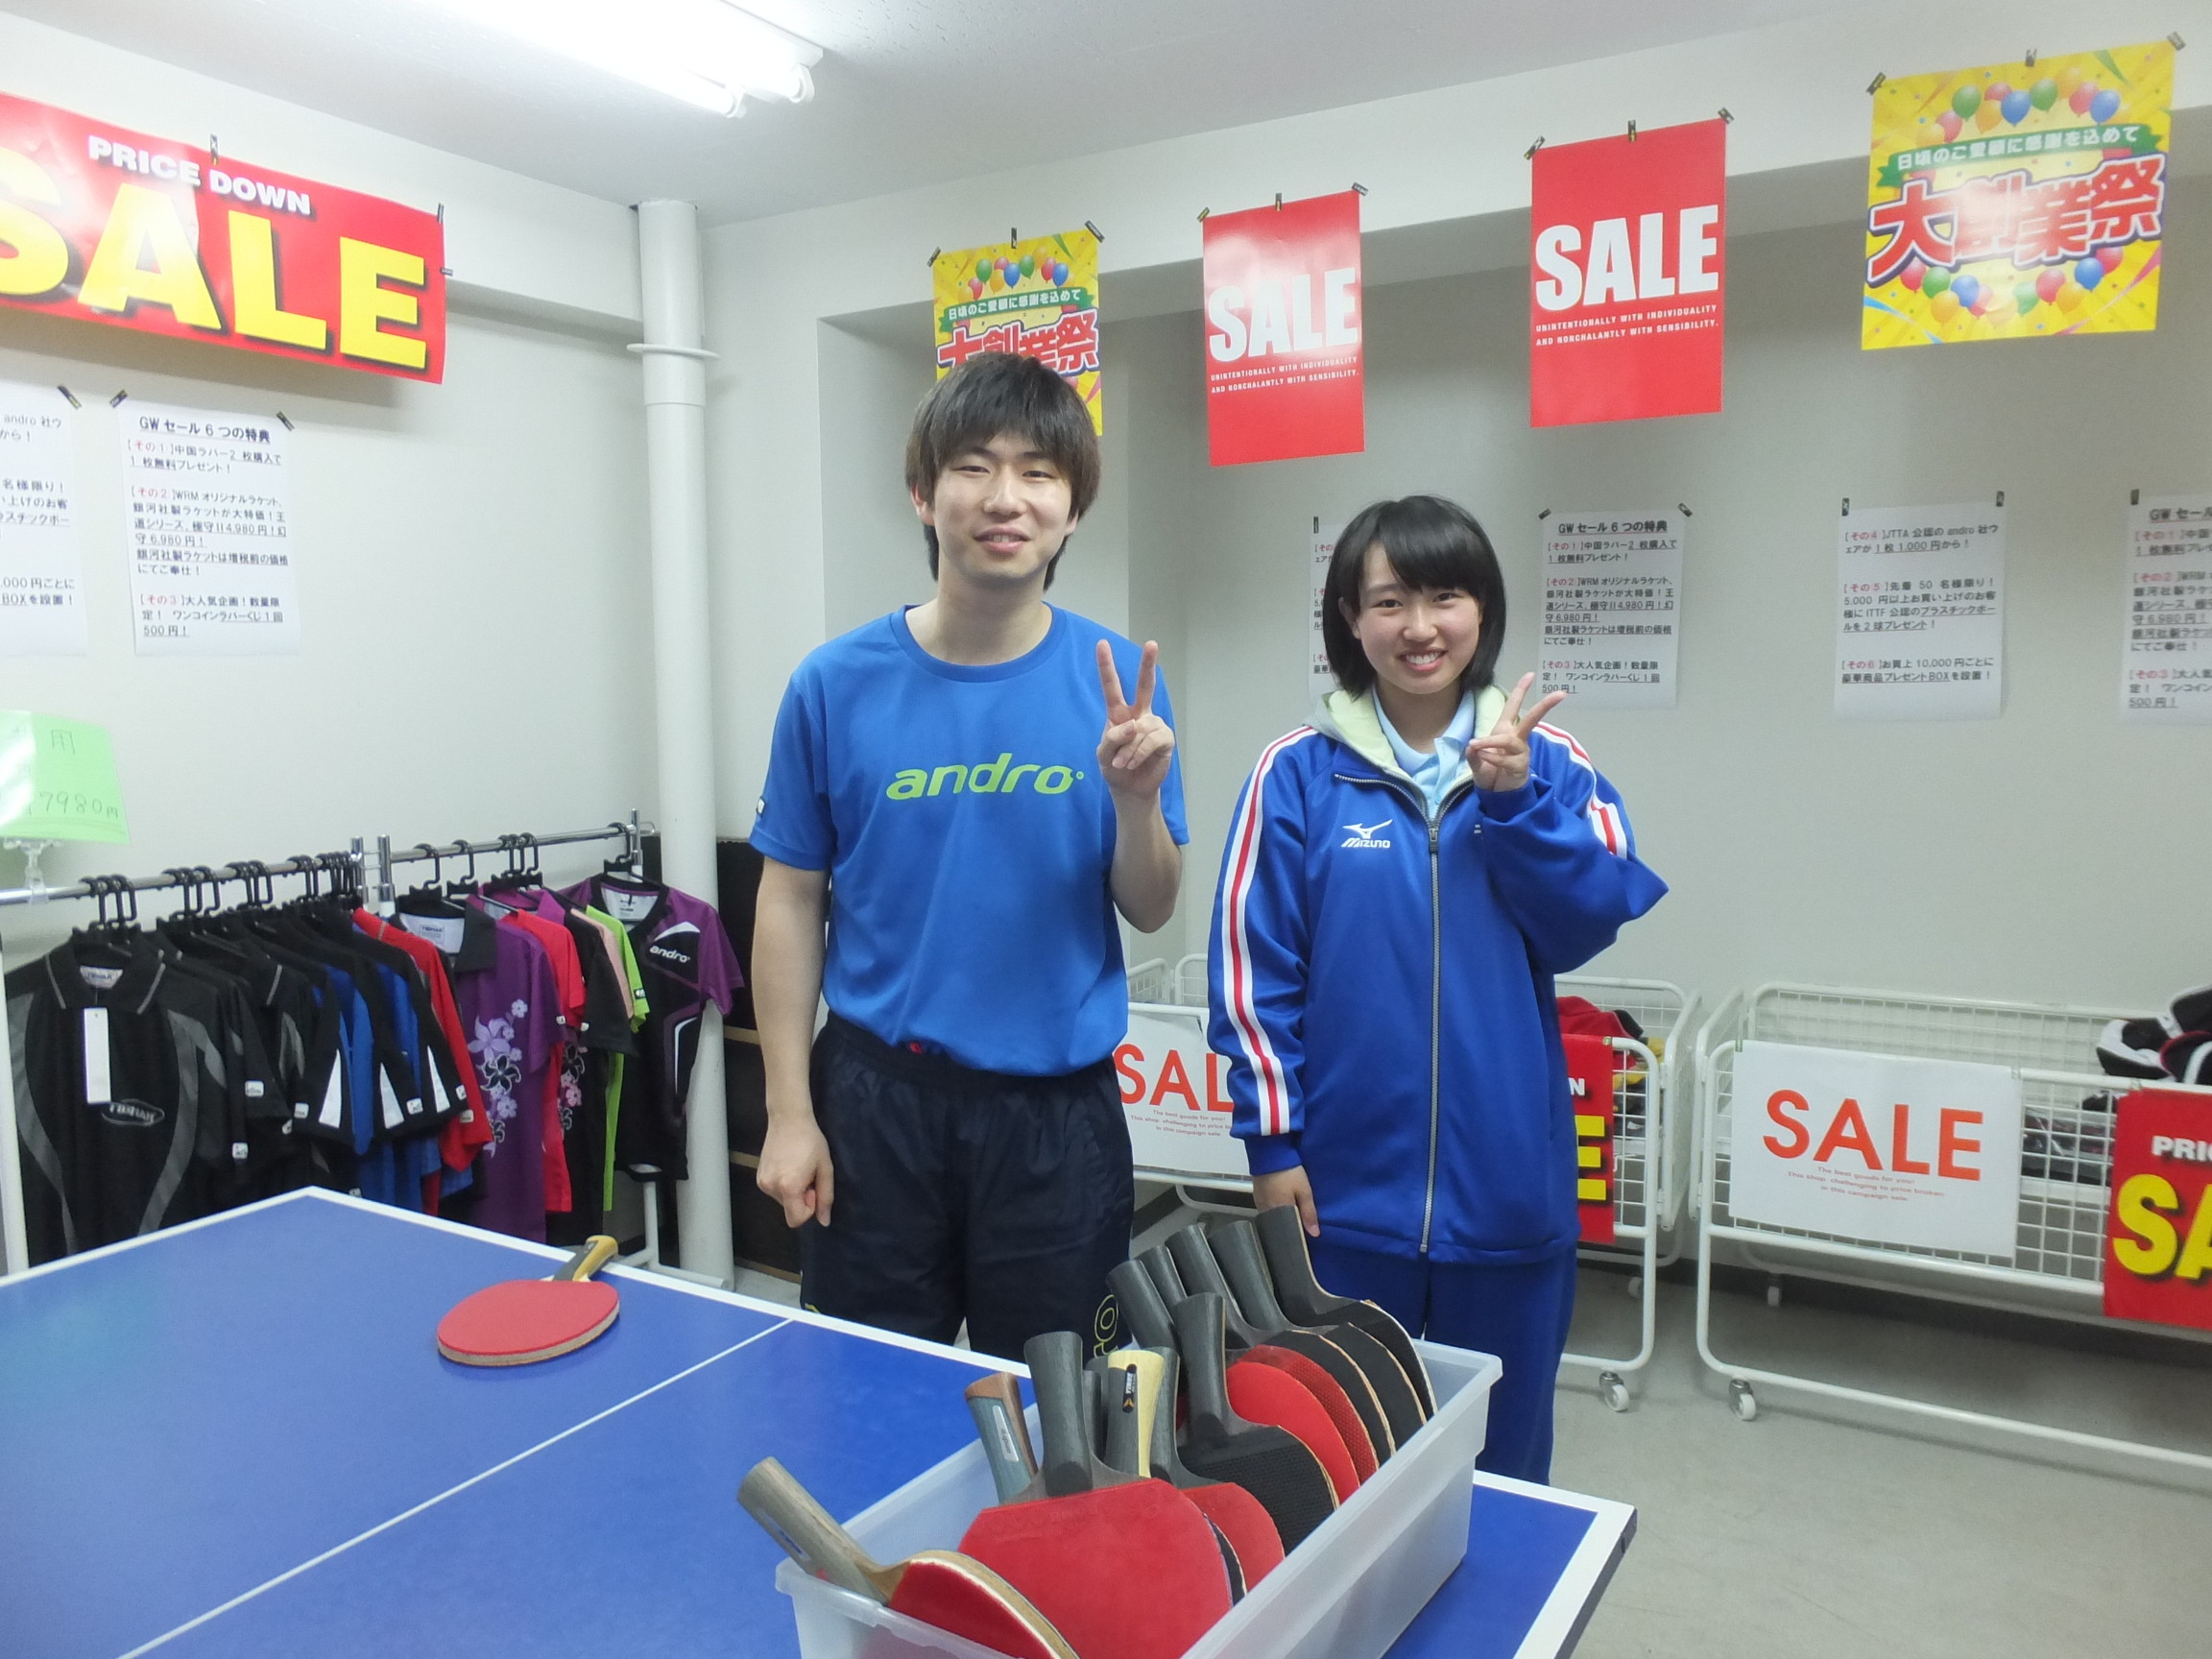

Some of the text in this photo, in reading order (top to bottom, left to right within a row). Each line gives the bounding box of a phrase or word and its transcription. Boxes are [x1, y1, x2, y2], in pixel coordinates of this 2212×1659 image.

[88, 135, 312, 215] PRICE DOWN
[1868, 154, 2164, 282] 大創業祭
[1535, 204, 1719, 311] SALE
[949, 289, 1081, 321] 日頃のご愛顧に感謝を込めて
[1208, 267, 1358, 362] SALE
[1536, 304, 1717, 332] UNINTENTIONALLY WITH INDIVIDUALITY
[1536, 337, 1553, 346] AND
[1630, 325, 1652, 336] WITH
[1279, 364, 1298, 373] WITH
[1301, 356, 1357, 370] INDIVIDUALITY
[1212, 385, 1226, 394] AND
[1287, 375, 1306, 384] WITH
[886, 753, 1074, 801] andro
[1341, 837, 1390, 849] MIZUNO
[650, 946, 687, 963] andro
[1163, 1119, 1197, 1129] challenging
[1175, 1128, 1207, 1137] campaign
[1763, 1089, 1984, 1182] SALE
[1788, 1170, 1804, 1179] This
[1830, 1177, 1878, 1190] challenging
[1890, 1186, 1912, 1194] price
[1816, 1166, 1832, 1174] The
[1834, 1168, 1852, 1177] best
[1853, 1172, 1880, 1181] goods
[1830, 1186, 1846, 1194] this
[1847, 1190, 1888, 1199] campaign
